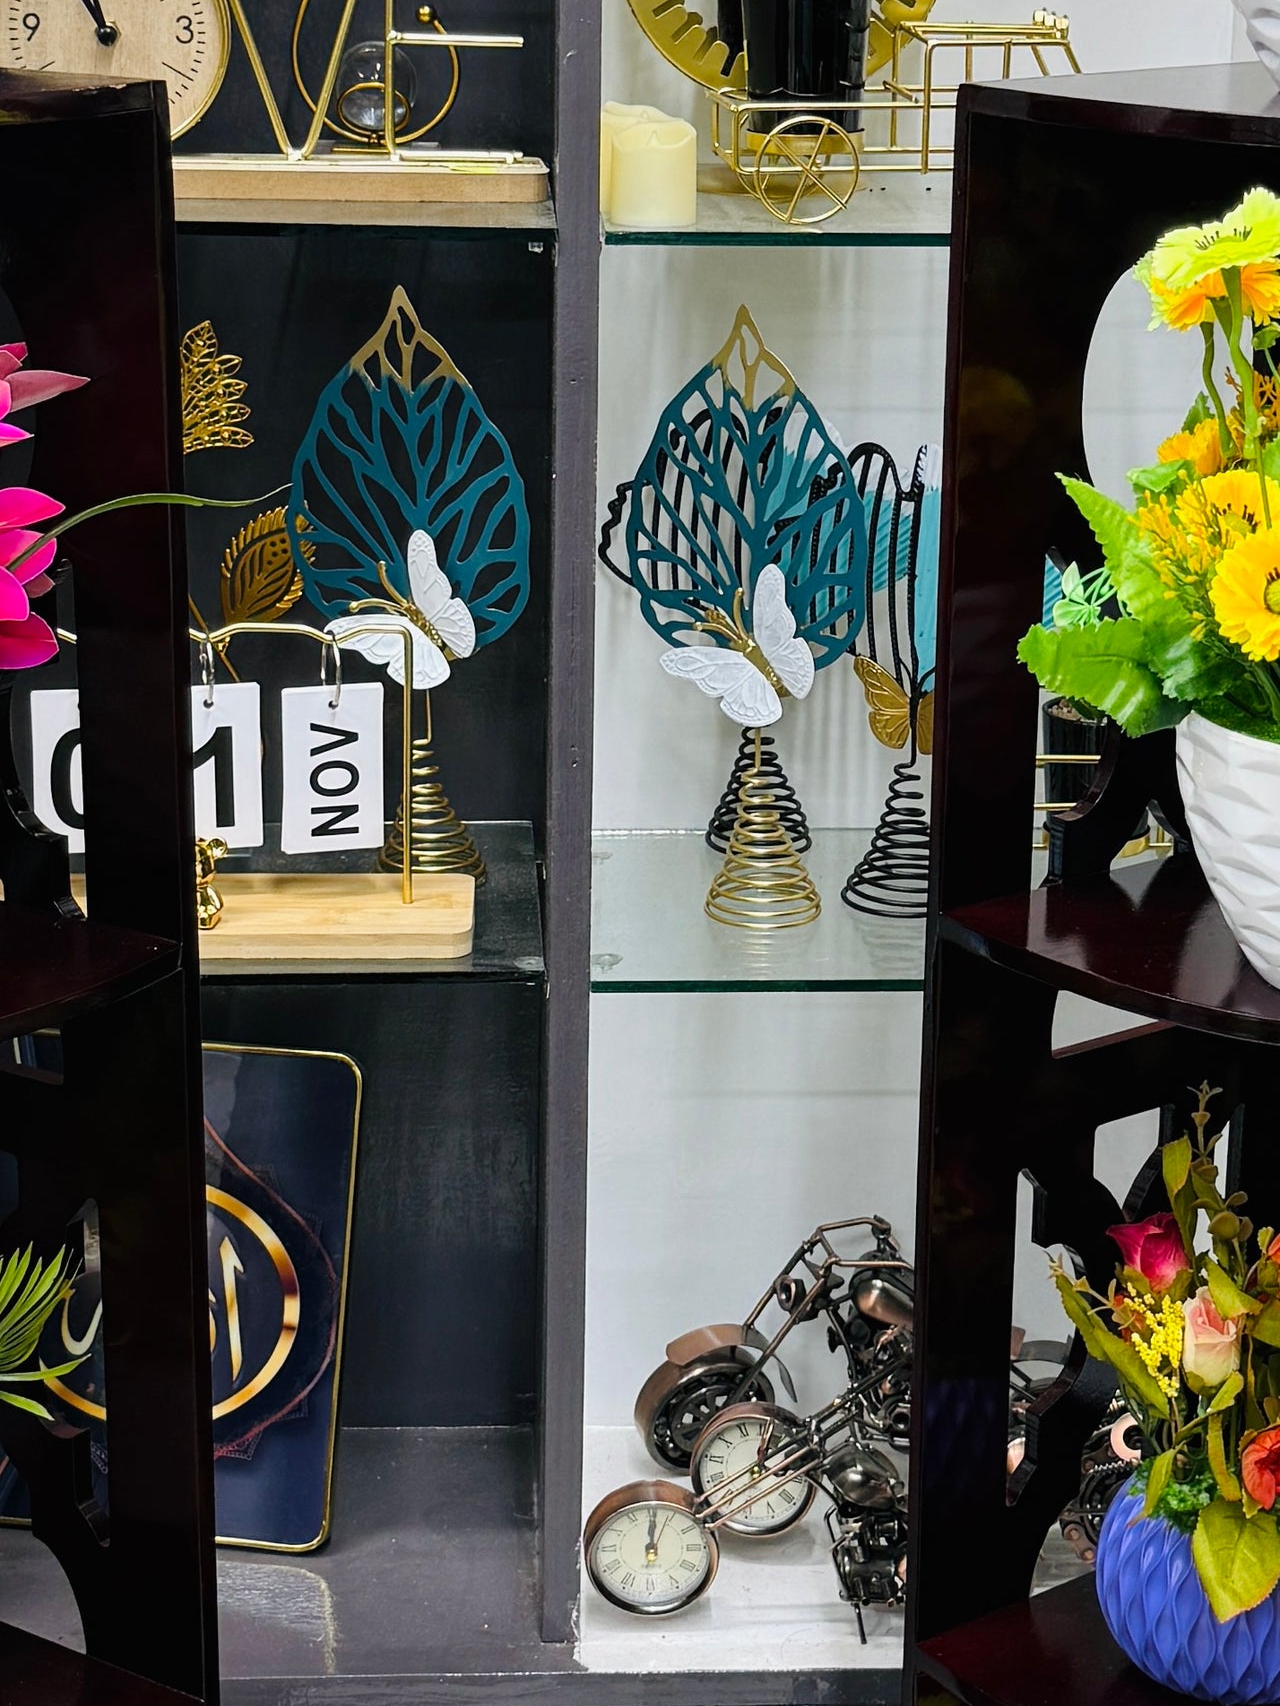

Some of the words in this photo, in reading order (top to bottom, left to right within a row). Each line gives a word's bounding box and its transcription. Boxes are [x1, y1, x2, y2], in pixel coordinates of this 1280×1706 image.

[22, 12, 41, 43] 9
[175, 15, 195, 45] 3
[309, 722, 360, 838] NOV
